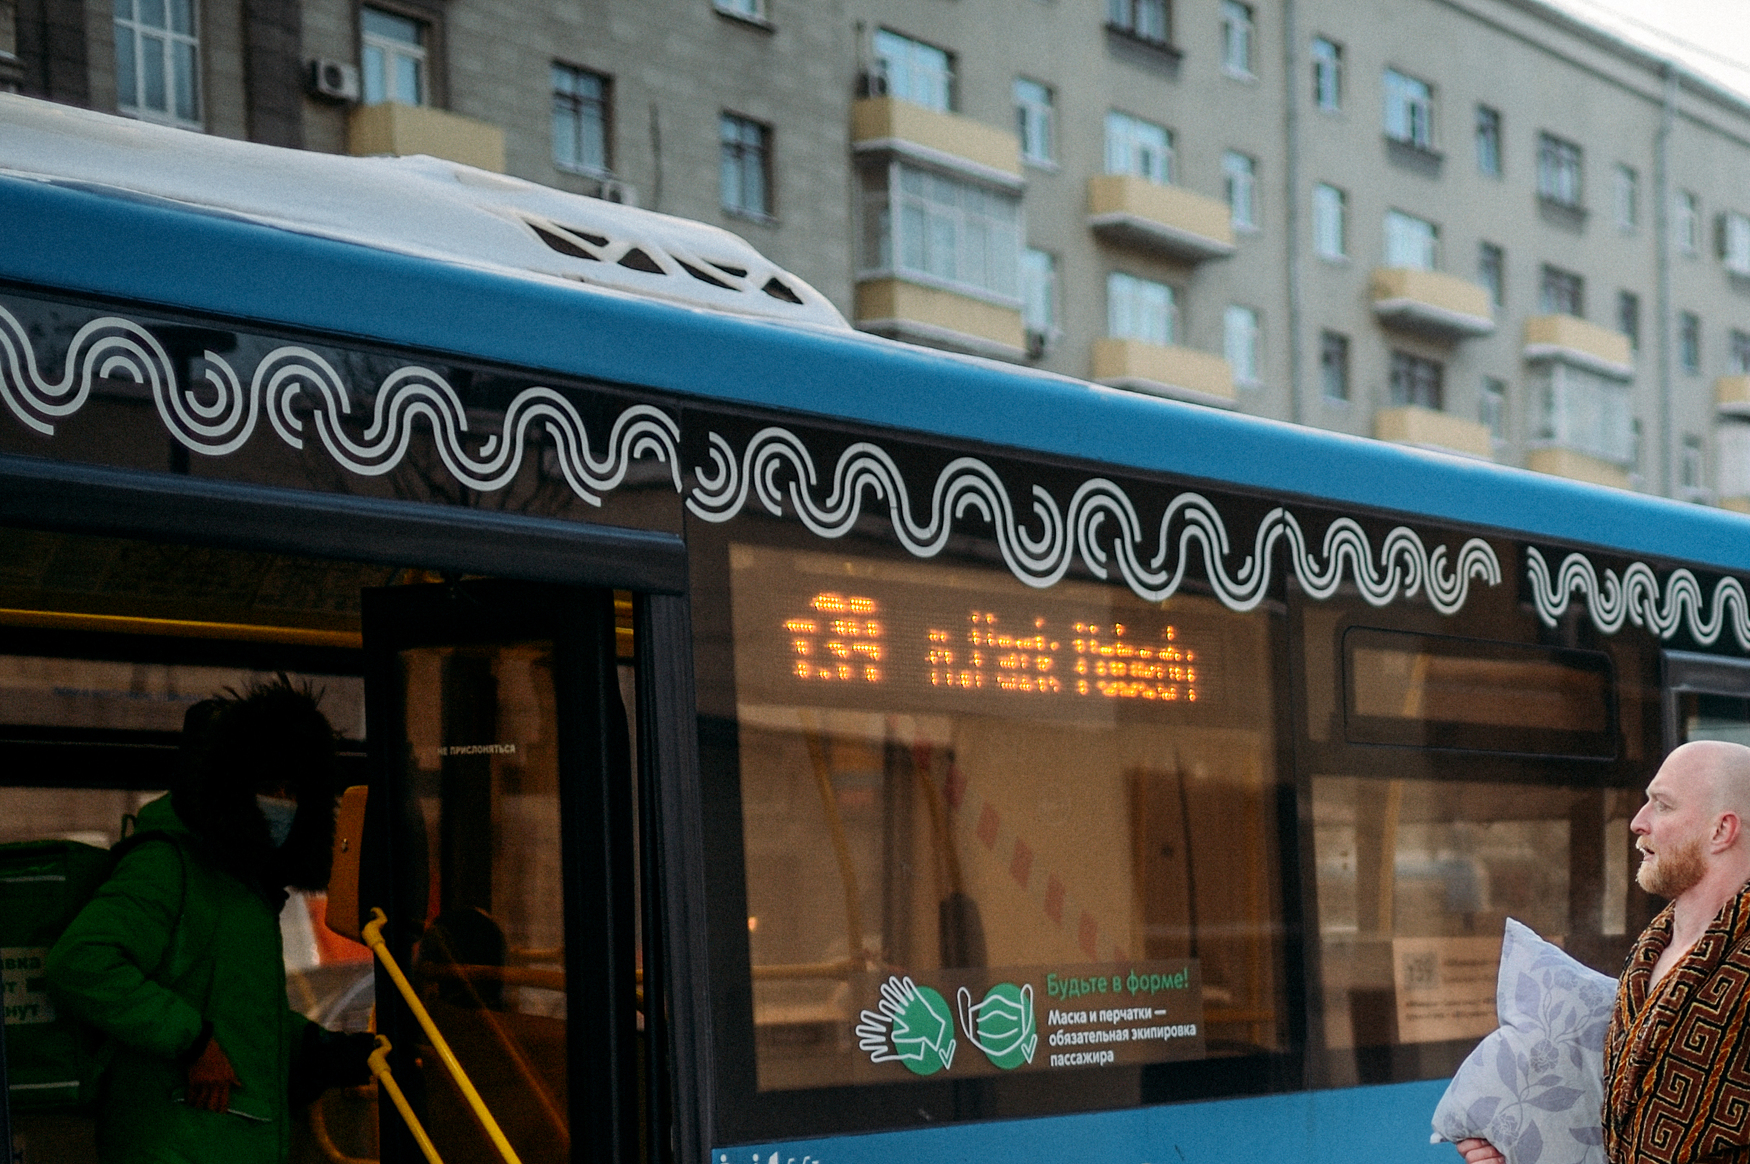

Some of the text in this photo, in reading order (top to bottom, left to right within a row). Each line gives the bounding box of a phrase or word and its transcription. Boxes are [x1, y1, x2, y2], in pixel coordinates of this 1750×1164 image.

[449, 743, 516, 756] ПРИСЛОНЯТЬСЯ
[1047, 967, 1189, 1001] Будьте в форме!
[1048, 1009, 1087, 1025] Маска
[1089, 1011, 1097, 1023] и
[1100, 1007, 1152, 1025] перчатки
[1049, 1023, 1197, 1047] обязательная экипировка
[1050, 1049, 1115, 1067] пассажира
